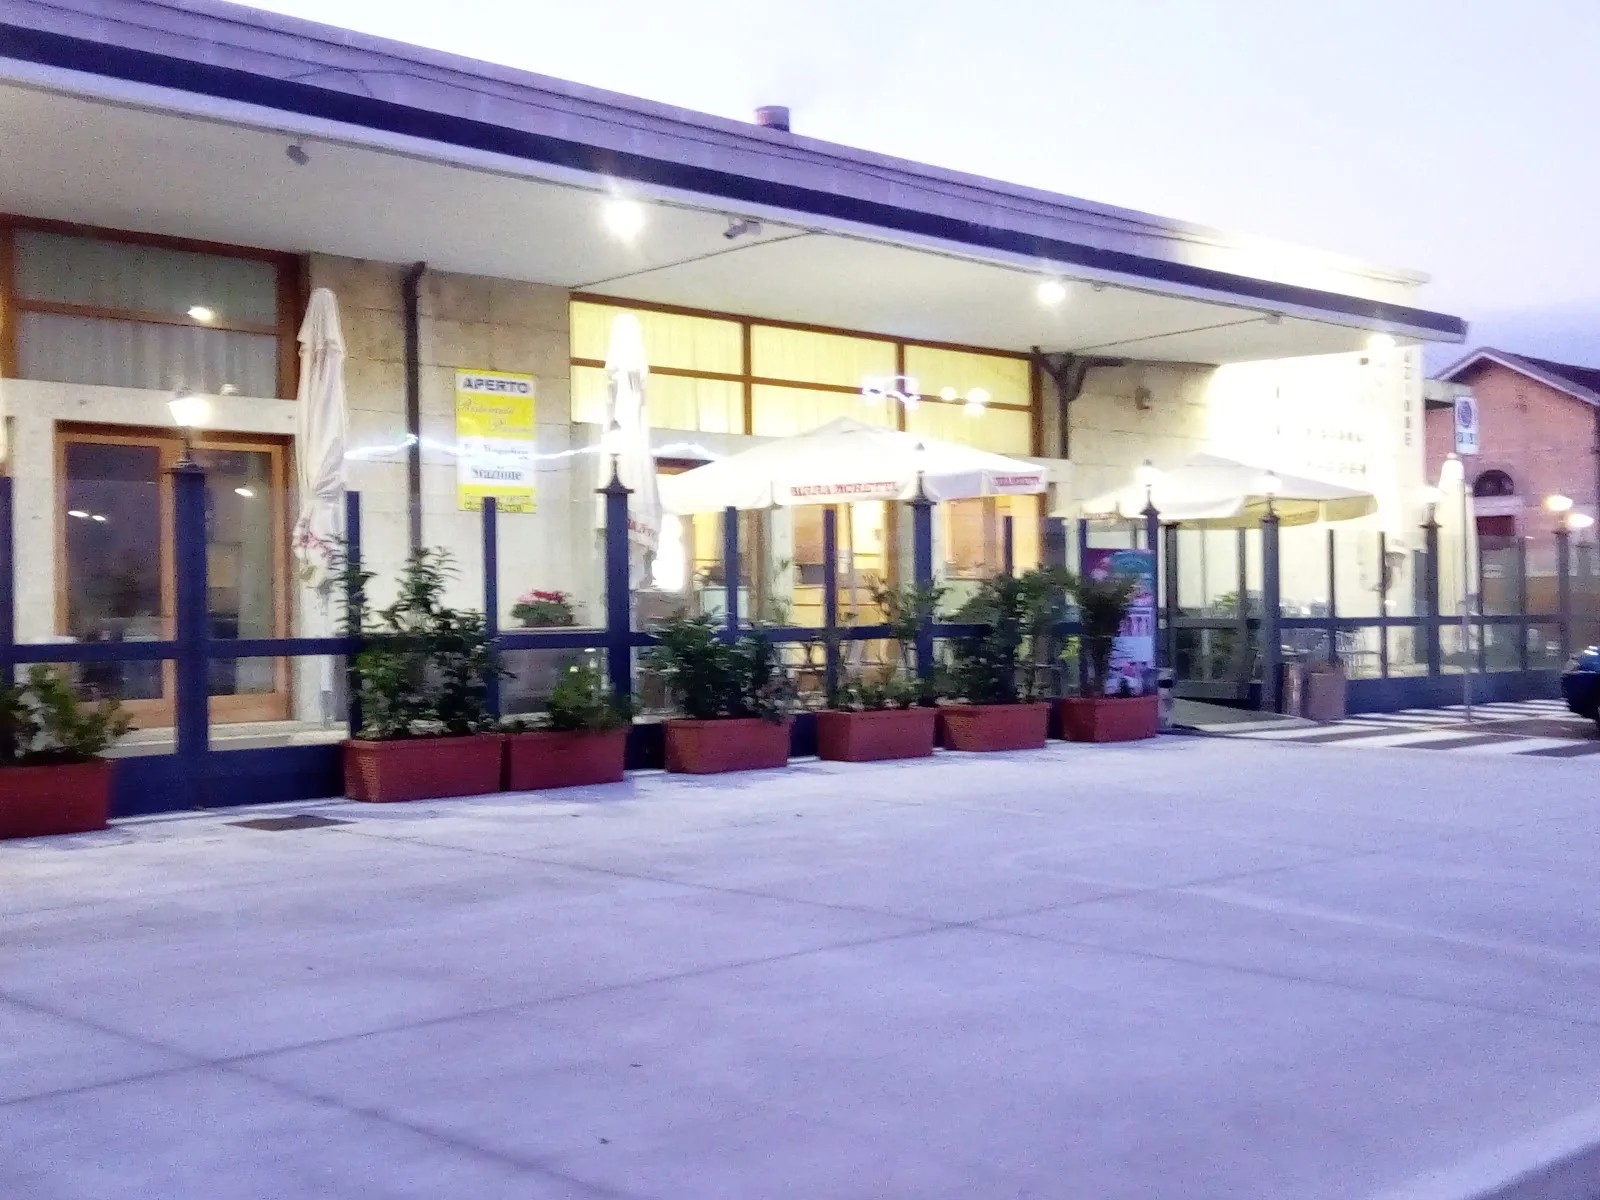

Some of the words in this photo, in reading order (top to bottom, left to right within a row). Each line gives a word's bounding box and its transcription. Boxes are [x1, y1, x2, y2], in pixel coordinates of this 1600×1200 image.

[464, 377, 529, 394] APERTO
[471, 468, 522, 480] Stazione
[790, 485, 831, 496] BIRRA
[834, 481, 900, 494] MORETTI
